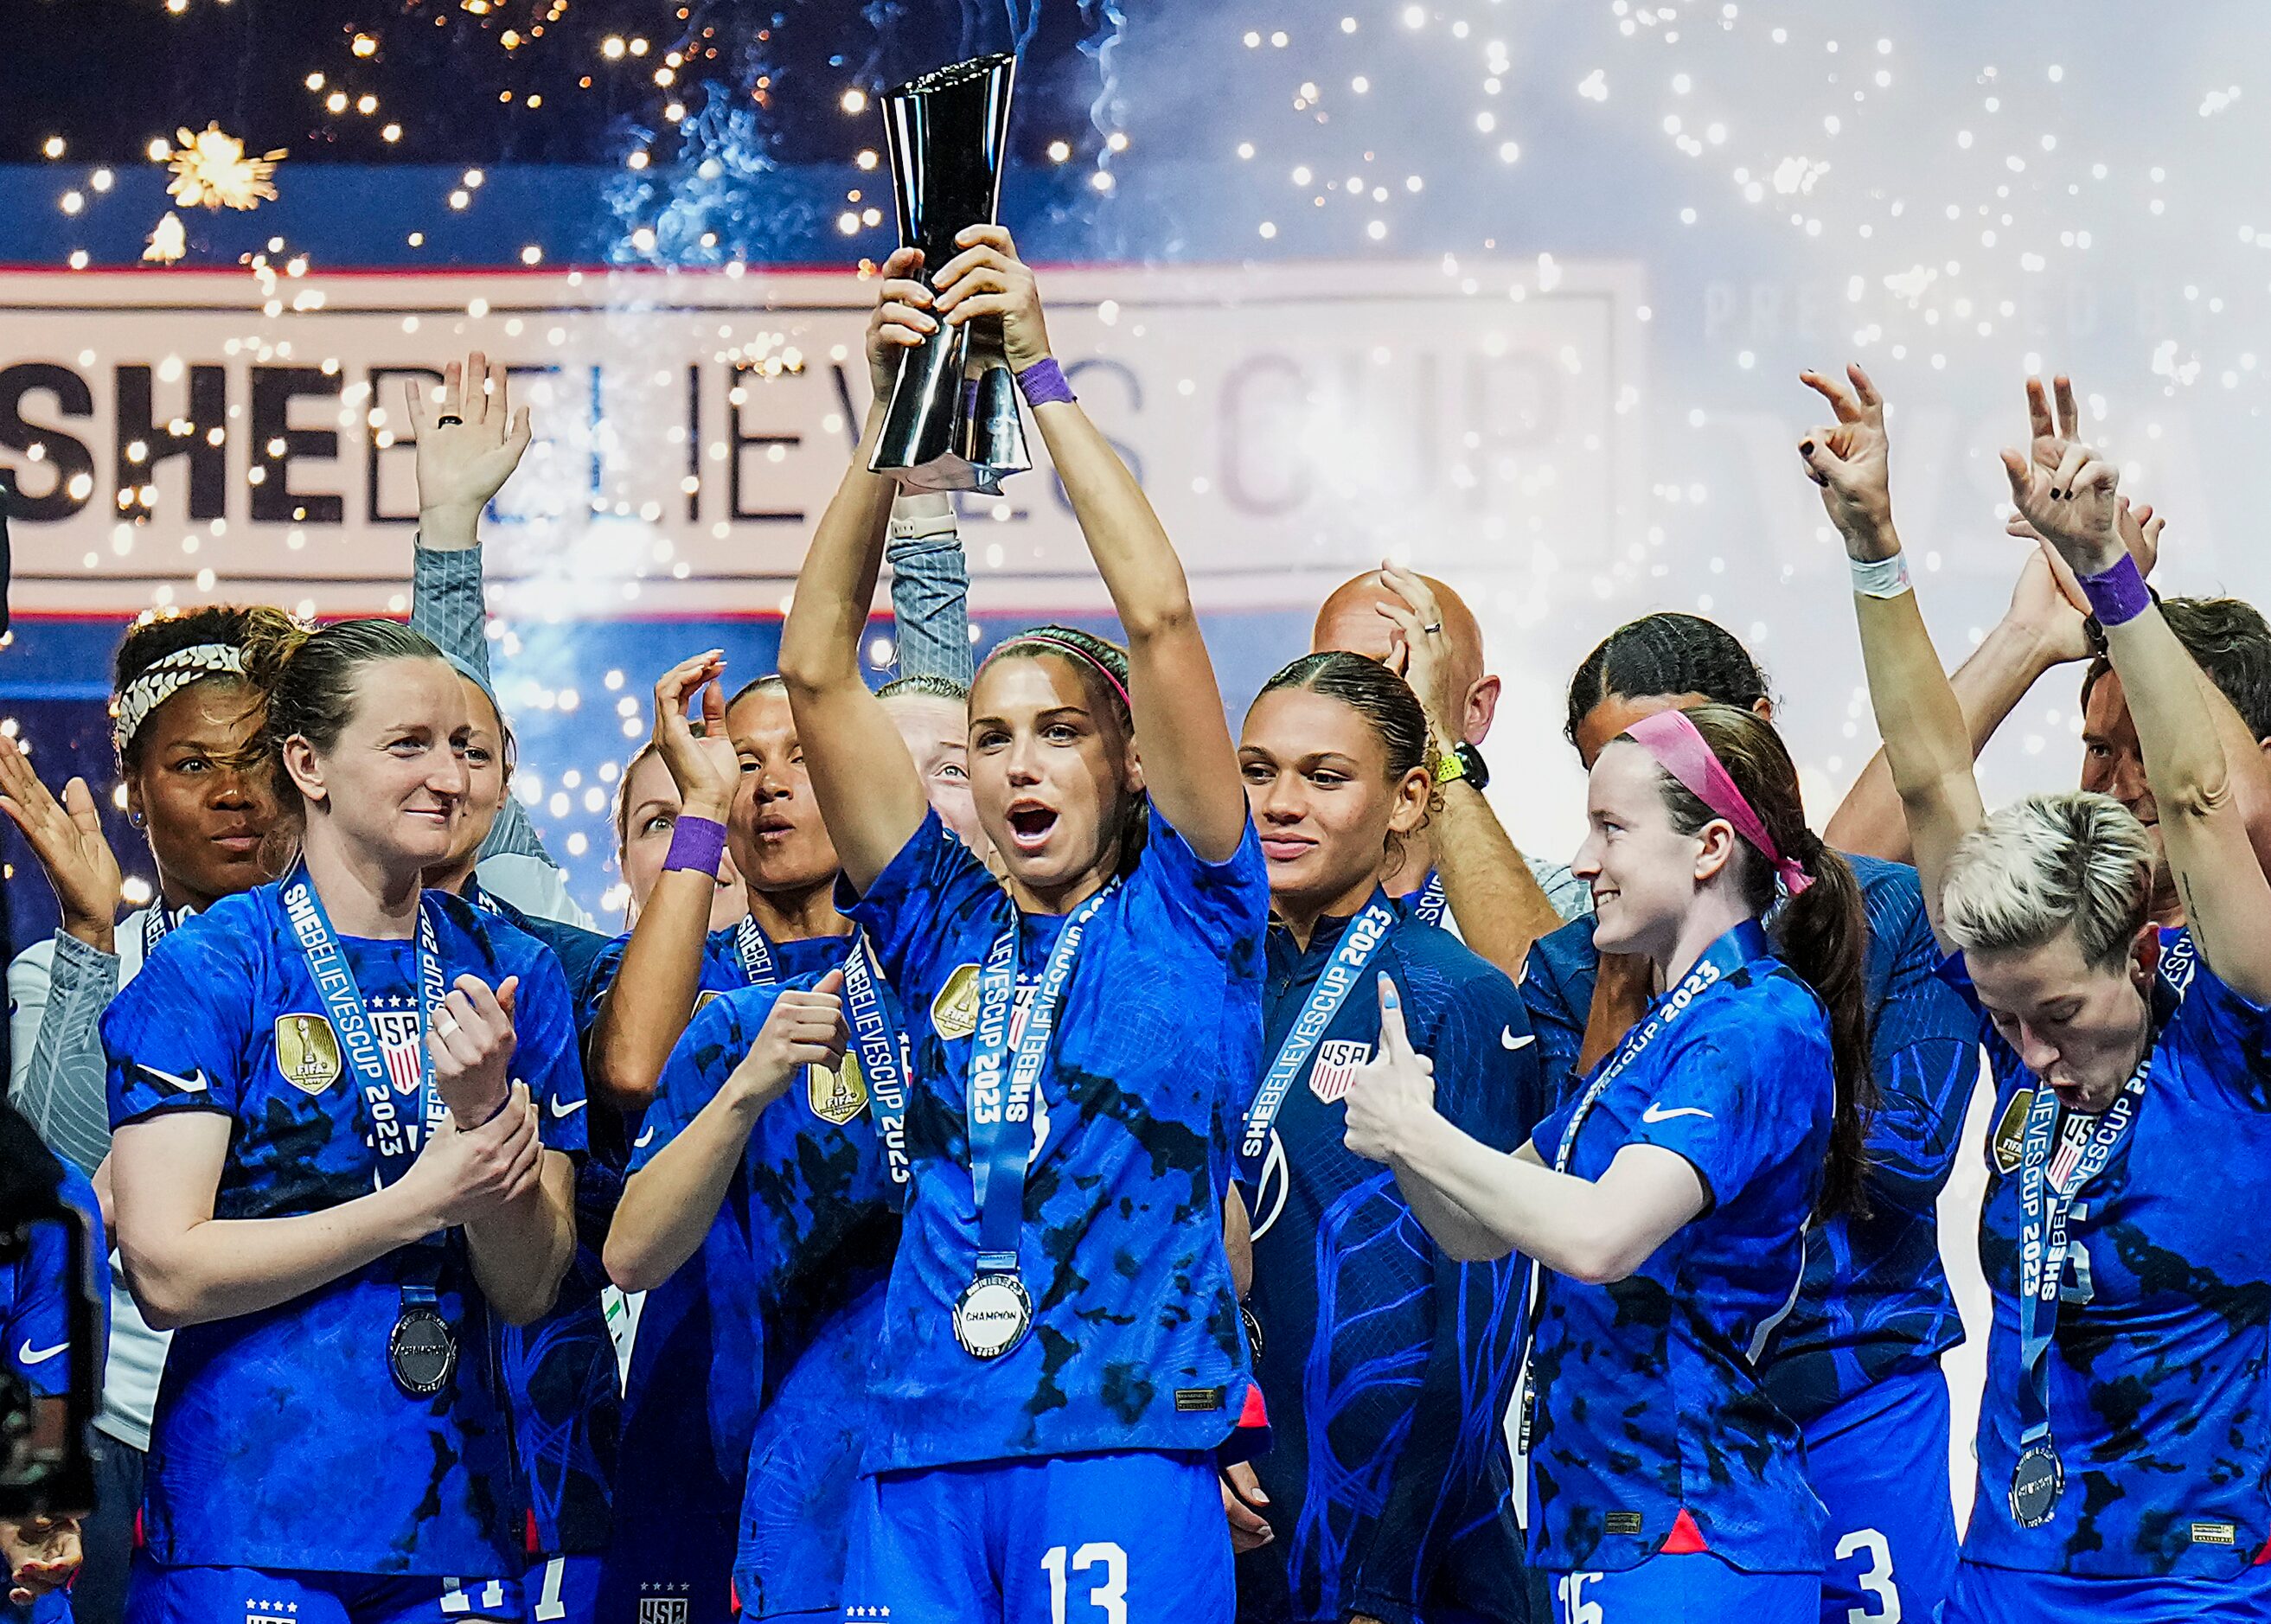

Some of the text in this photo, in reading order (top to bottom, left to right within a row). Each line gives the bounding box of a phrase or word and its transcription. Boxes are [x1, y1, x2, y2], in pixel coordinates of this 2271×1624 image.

[0, 349, 1569, 526] SHEBELIES CUP
[284, 883, 404, 1156] SHEBELIEVESCUP 2023
[842, 943, 904, 1109] SHEBELIEVESCUP
[944, 1007, 969, 1024] FIFA
[1660, 959, 1721, 1023] 2023
[1242, 905, 1392, 1157] SHEBELIEVESCUP 2023
[1321, 1044, 1366, 1066] USA
[296, 1064, 324, 1076] FIFA
[826, 1095, 854, 1109] FIFA
[973, 1052, 1001, 1125] 2023
[2041, 1097, 2133, 1301] SHEBELIEVESCUP
[2022, 1222, 2041, 1297] 2023
[965, 1309, 1017, 1322] CHAMPION
[1040, 1543, 1128, 1624] 13
[1835, 1528, 1901, 1624] 3
